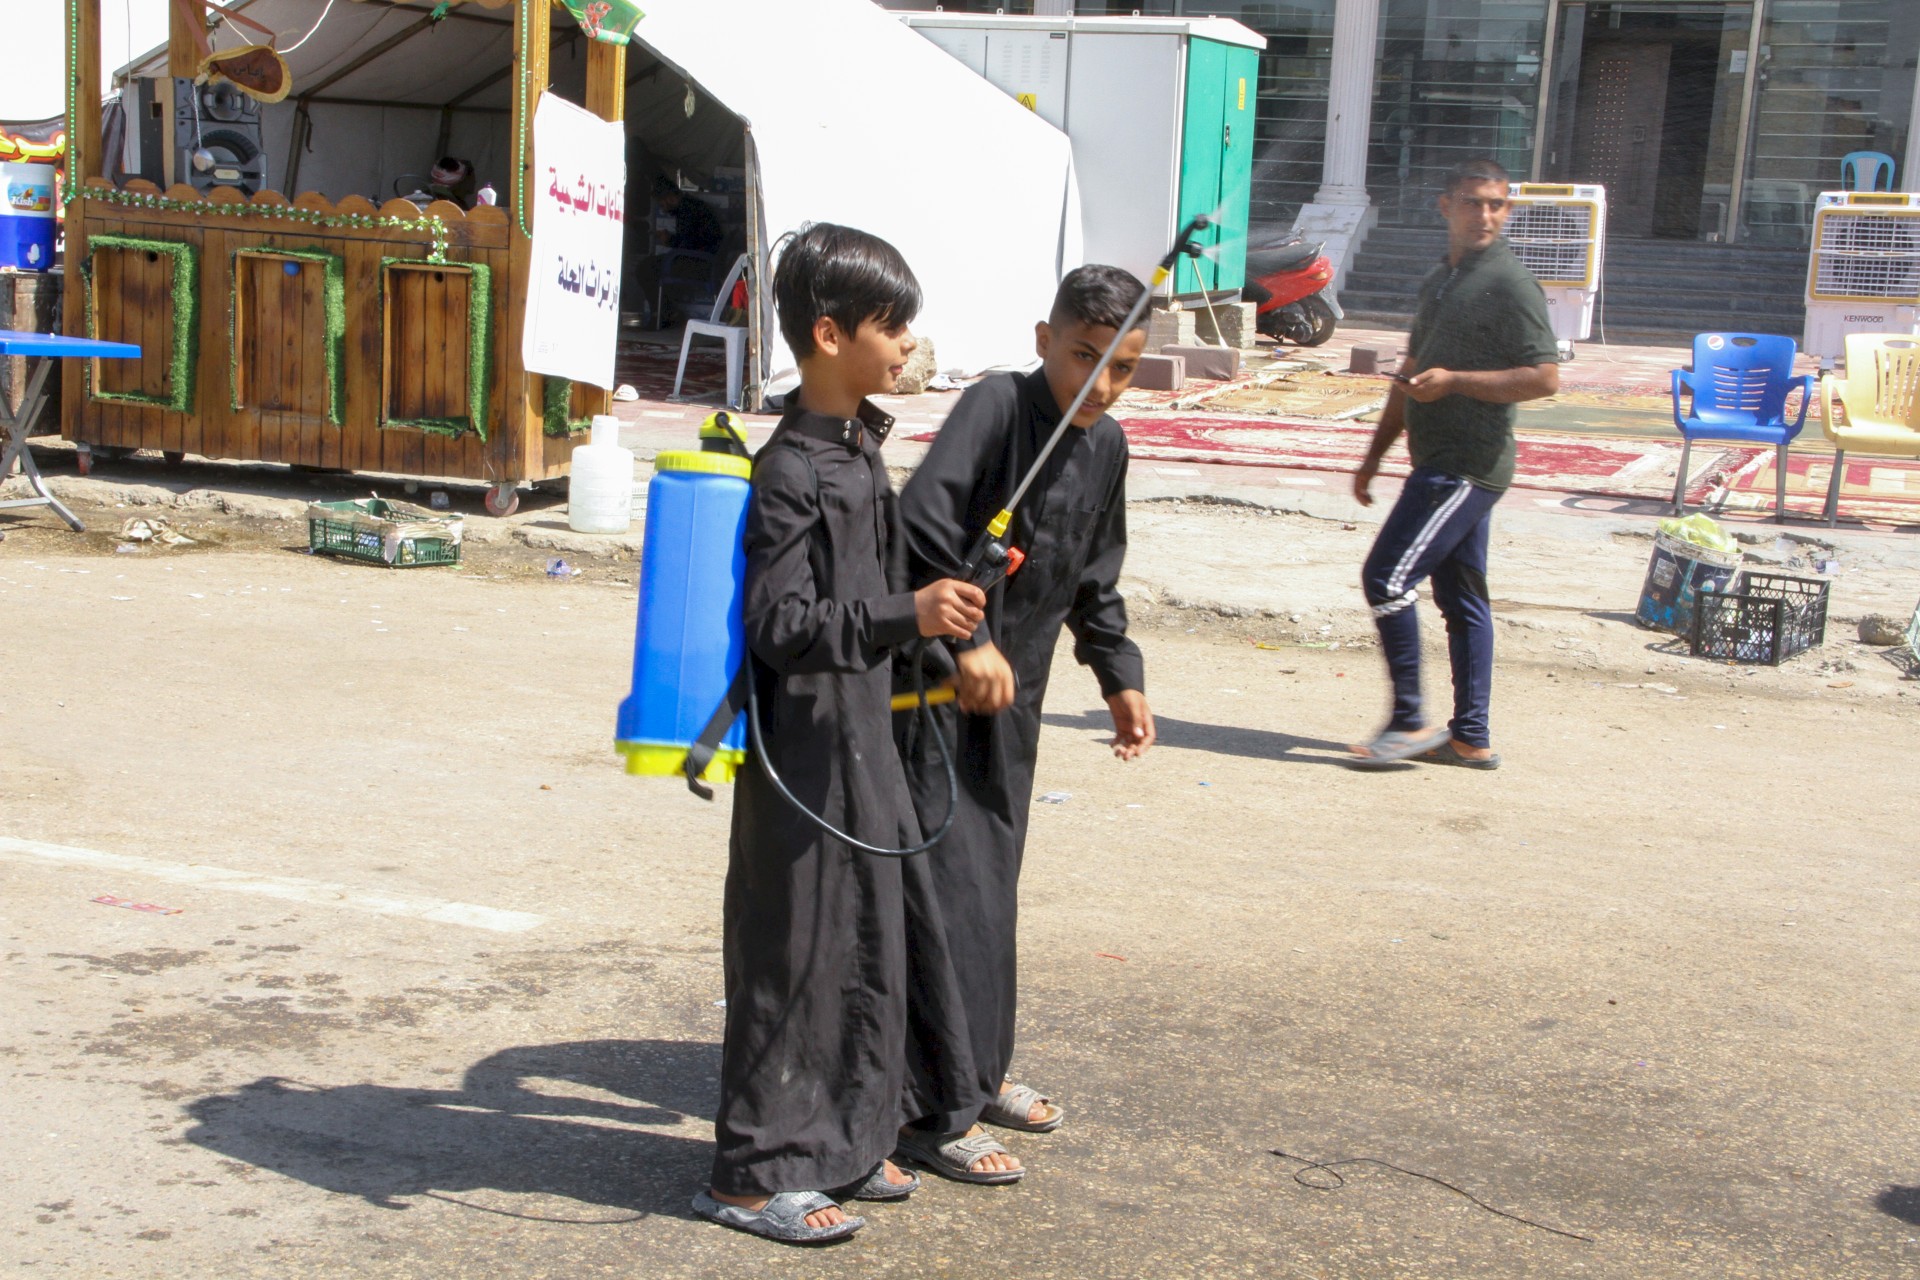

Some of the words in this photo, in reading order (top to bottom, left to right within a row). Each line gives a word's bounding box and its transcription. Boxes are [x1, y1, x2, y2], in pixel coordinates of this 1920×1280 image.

[12, 195, 34, 207] Kish
[586, 259, 612, 309] تراث
[1843, 314, 1884, 323] KENWOOD
